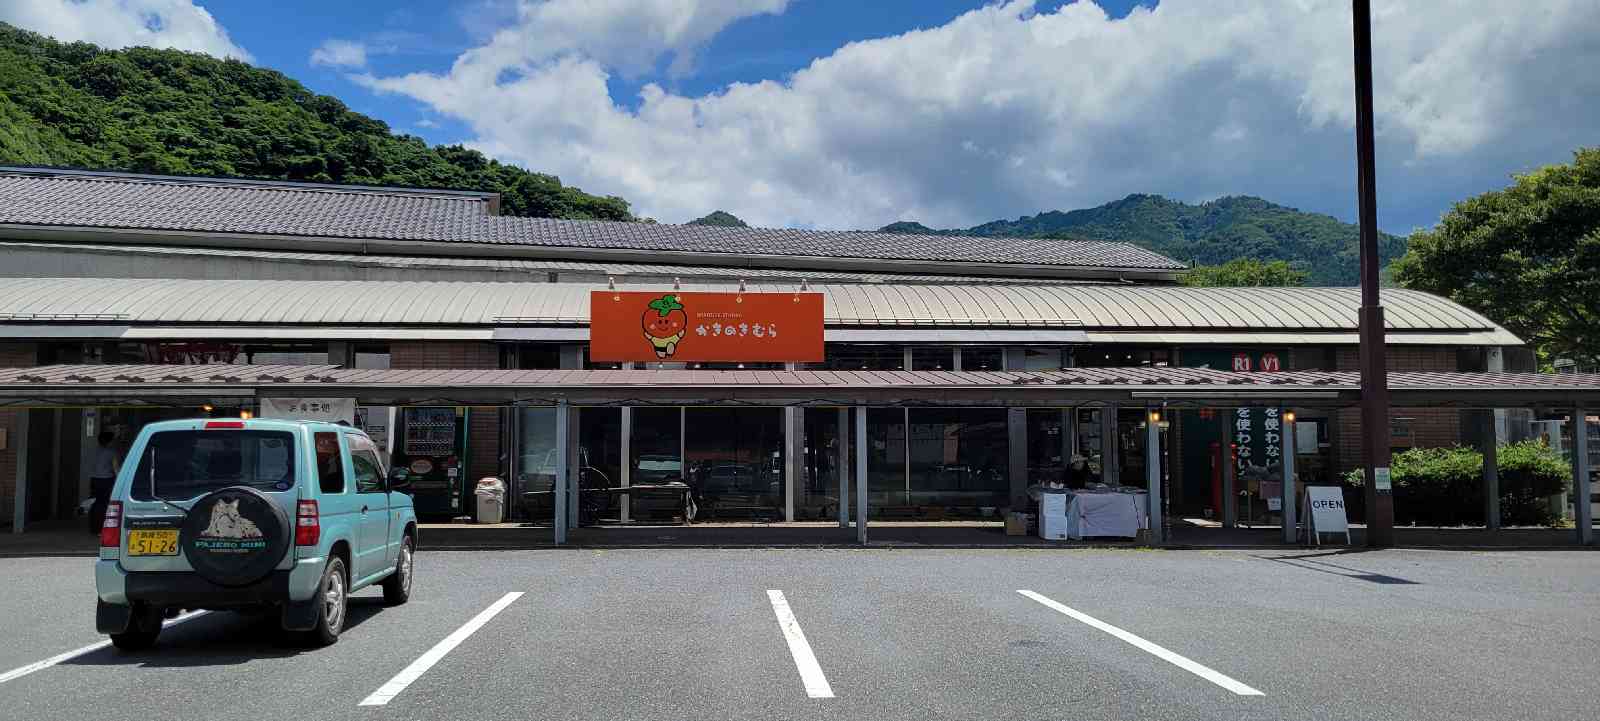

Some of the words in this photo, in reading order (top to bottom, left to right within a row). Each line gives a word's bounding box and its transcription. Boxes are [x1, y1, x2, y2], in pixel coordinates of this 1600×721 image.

[1233, 357, 1251, 371] R1
[1262, 357, 1280, 371] V1
[1312, 500, 1344, 509] OPEN
[138, 540, 176, 552] 51-26
